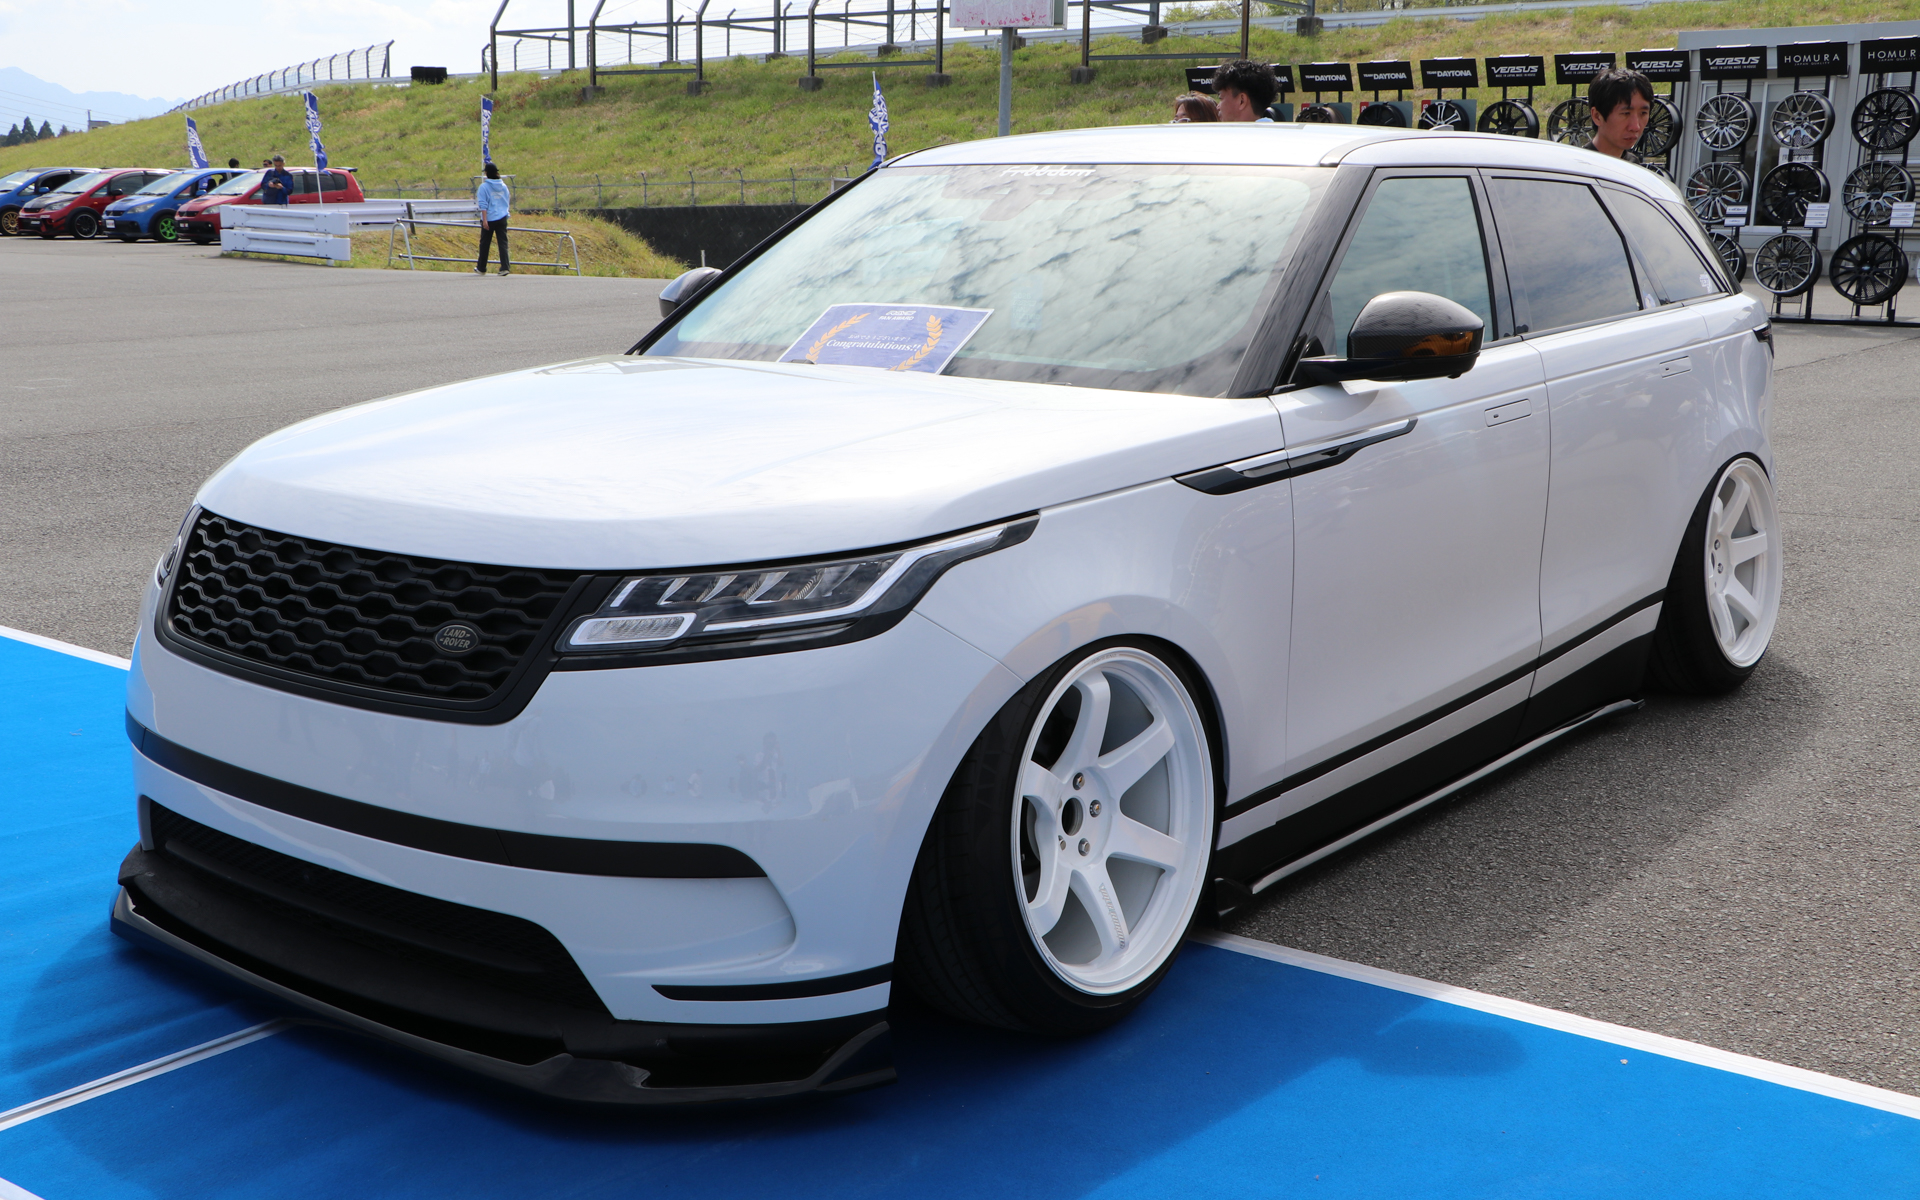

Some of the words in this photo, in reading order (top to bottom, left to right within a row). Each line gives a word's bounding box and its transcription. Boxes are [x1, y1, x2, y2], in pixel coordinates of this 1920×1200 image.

[1784, 53, 1840, 64] HOMURA
[1867, 48, 1920, 60] HOMUR
[1631, 60, 1684, 69] VERSUS
[1706, 56, 1761, 66] VERSUS
[1491, 65, 1539, 74] VERSUS
[1560, 62, 1611, 71] VERSUS
[1314, 74, 1348, 82] DAYTONA
[1373, 72, 1407, 80] DAYTONA
[1437, 69, 1472, 78] DAYTONA
[826, 339, 922, 352] Congratulations!!
